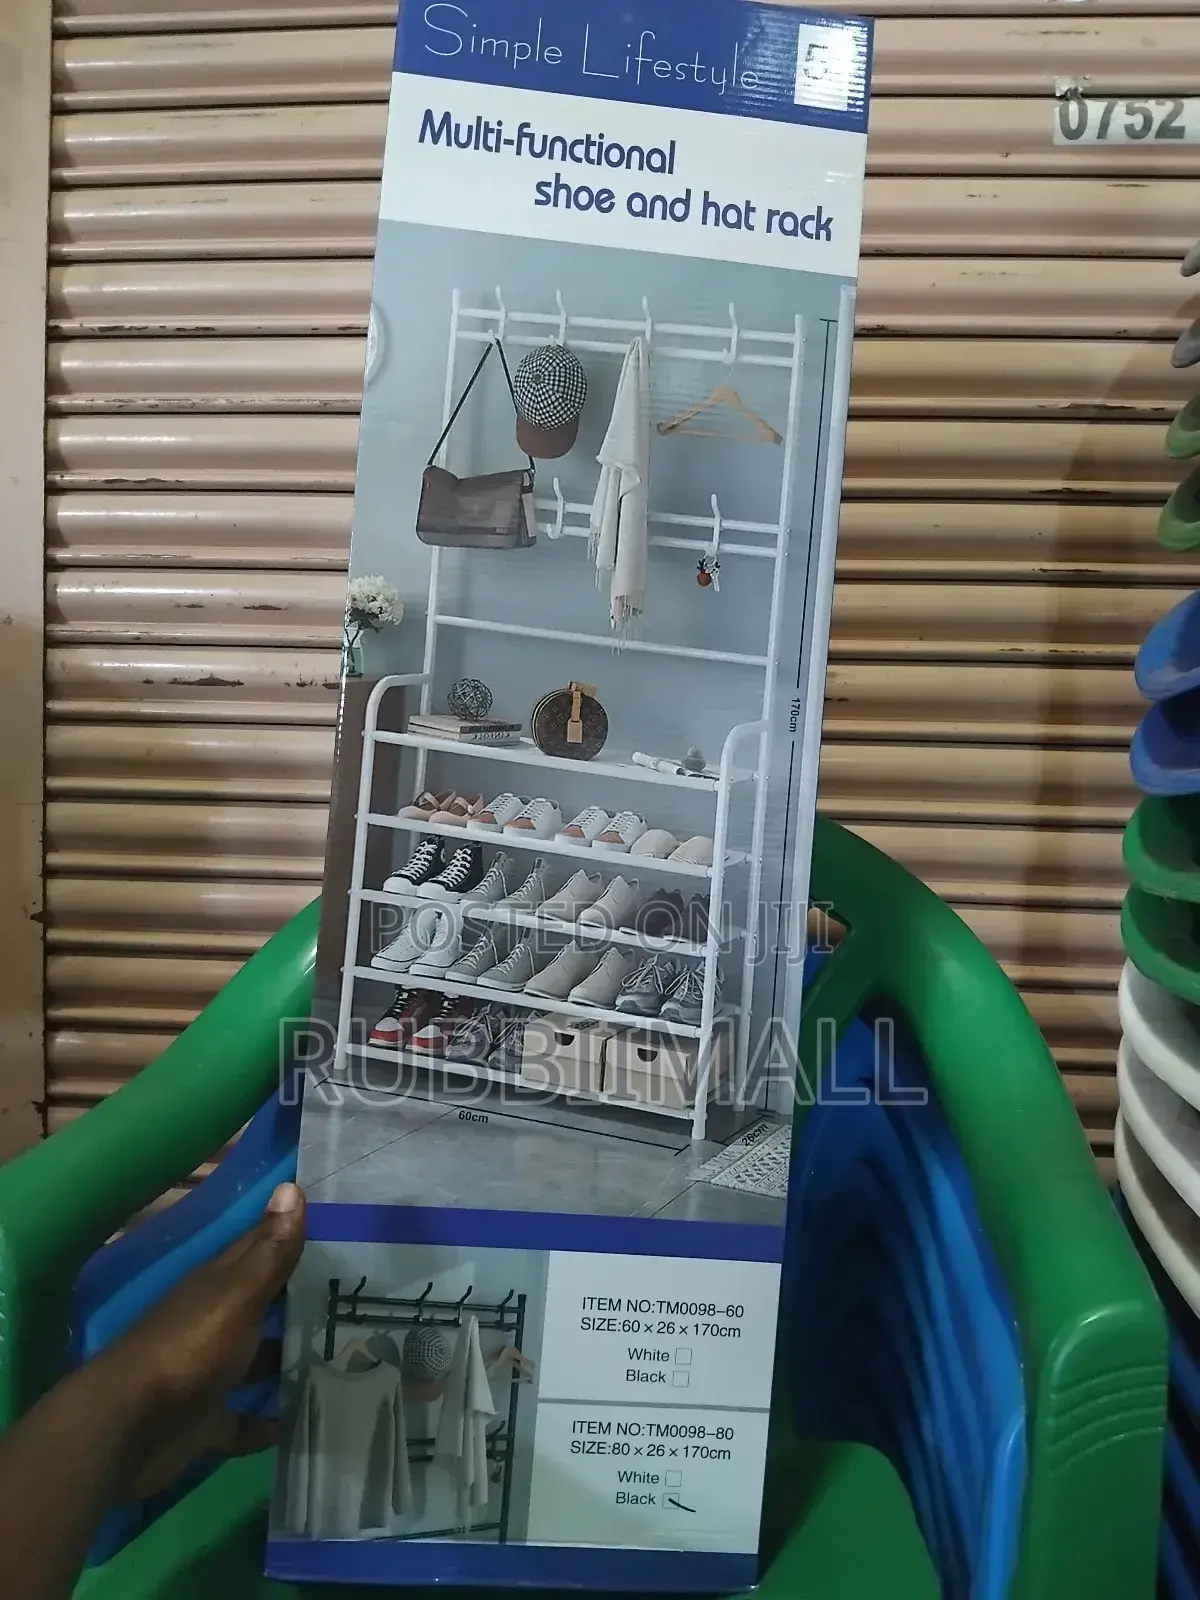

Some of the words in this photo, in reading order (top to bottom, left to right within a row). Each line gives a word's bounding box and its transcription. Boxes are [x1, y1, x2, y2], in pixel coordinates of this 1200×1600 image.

[423, 3, 563, 70] Simple
[582, 23, 760, 94] Lifestyle
[1058, 88, 1186, 141] 0752
[418, 108, 676, 175] Multi-functional
[534, 173, 616, 213] shoe
[626, 188, 691, 223] and
[701, 190, 756, 232] hat
[765, 206, 834, 242] rack
[789, 697, 801, 733] 170cm
[458, 1110, 489, 1124] 60cm
[741, 1123, 769, 1147] 26cm
[582, 1296, 622, 1312] ITEM
[580, 1317, 641, 1333] SIZE:60
[656, 1321, 676, 1335] 26
[692, 1323, 742, 1338] 170cm
[627, 1347, 670, 1362] White
[625, 1369, 667, 1383] Black
[572, 1420, 612, 1436] ITEM
[570, 1440, 631, 1457] SIZE:80
[646, 1444, 666, 1457] 26
[681, 1446, 732, 1460] 170cm
[617, 1470, 660, 1484] White
[615, 1491, 657, 1505] Black
